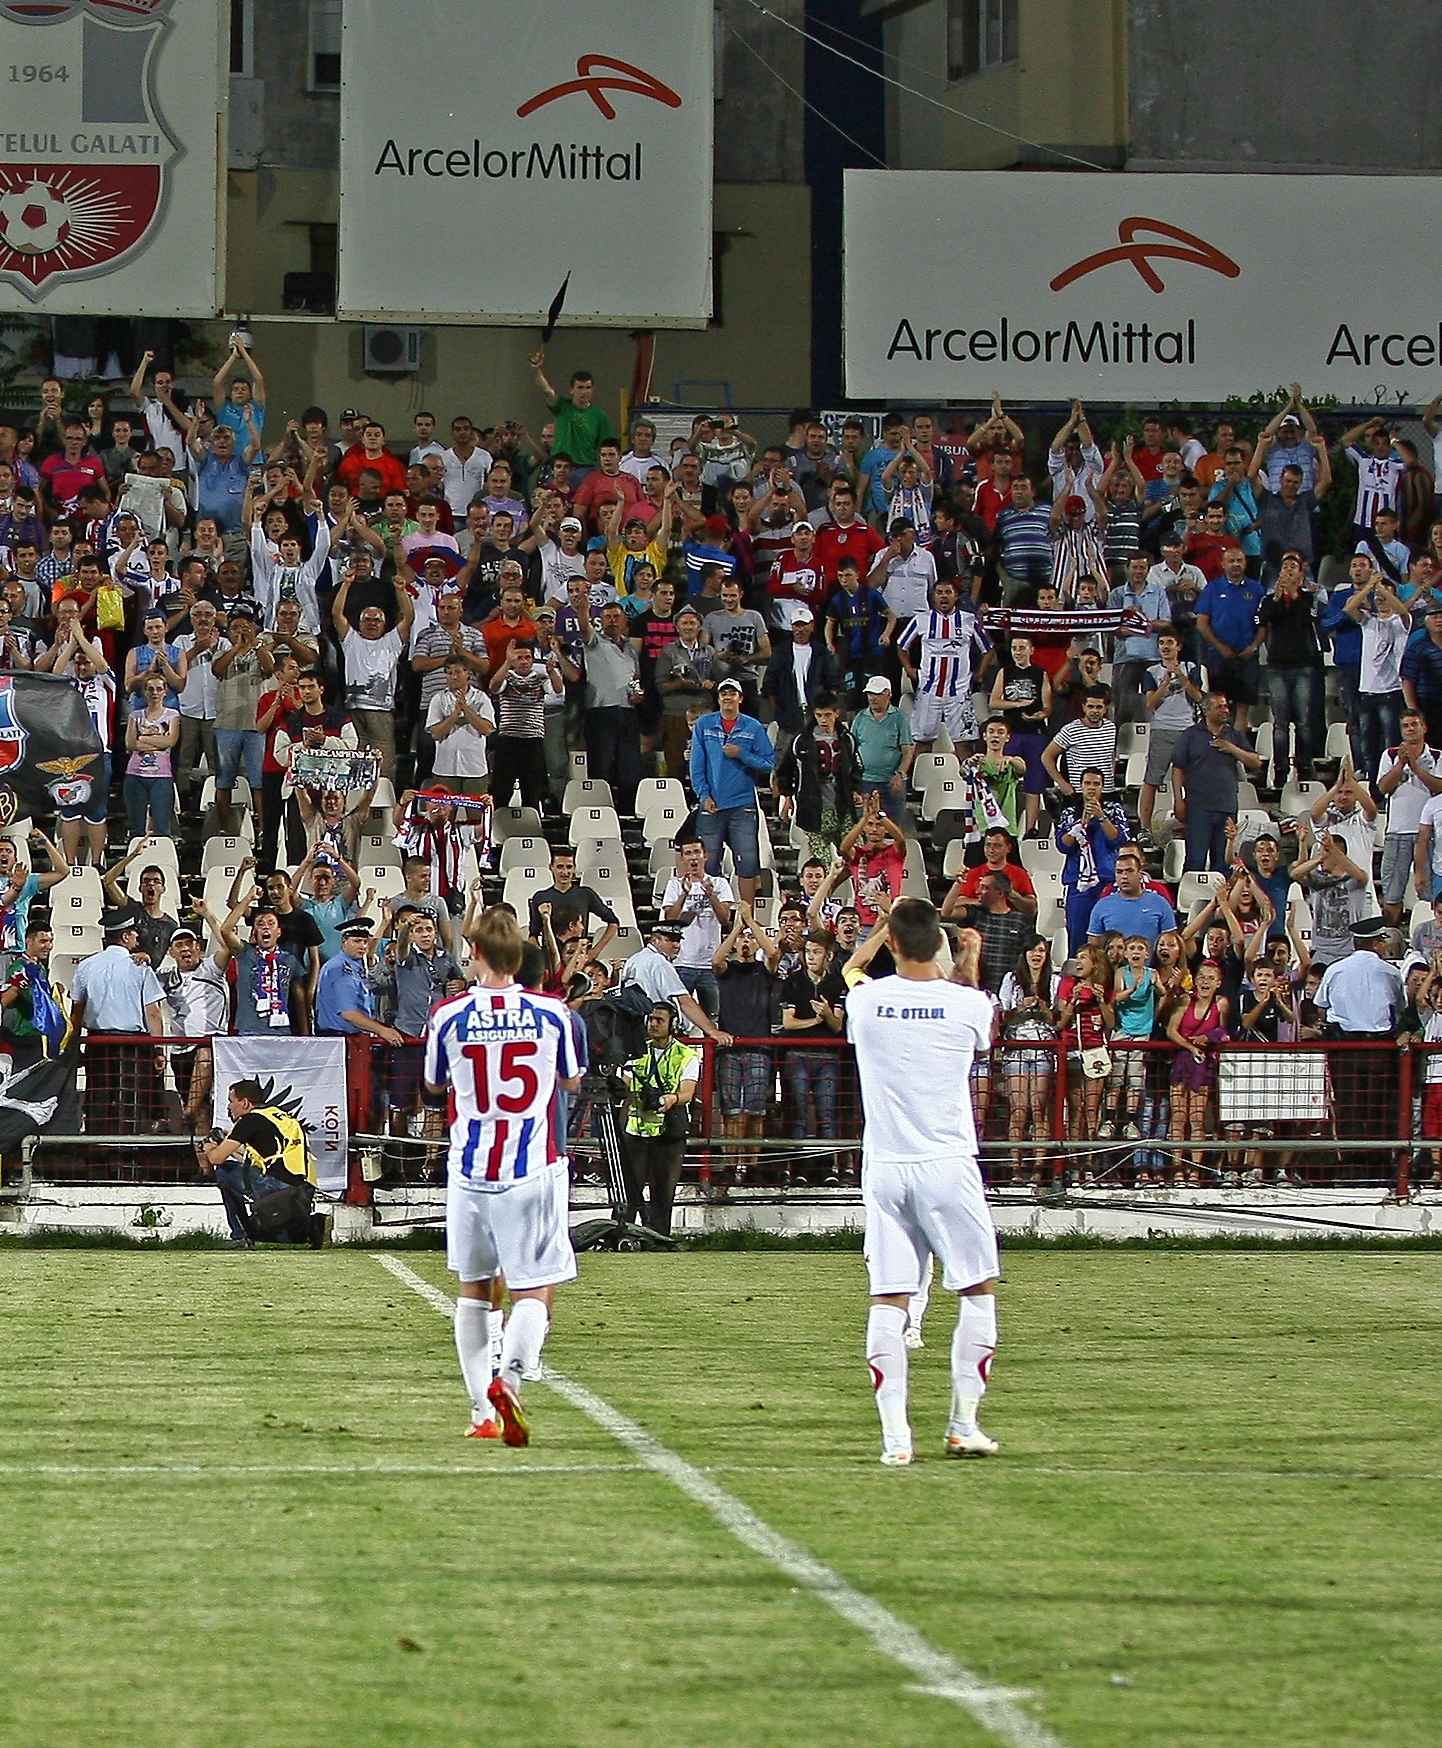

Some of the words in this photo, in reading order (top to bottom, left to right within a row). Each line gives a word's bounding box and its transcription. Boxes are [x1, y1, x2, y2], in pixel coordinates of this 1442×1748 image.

[9, 65, 70, 83] 1964
[71, 134, 160, 154] GALATI
[374, 138, 642, 181] ArcelorMittal
[886, 316, 1195, 365] ArcelorMittal
[466, 1008, 536, 1029] ASTRA
[461, 1042, 538, 1114] 15
